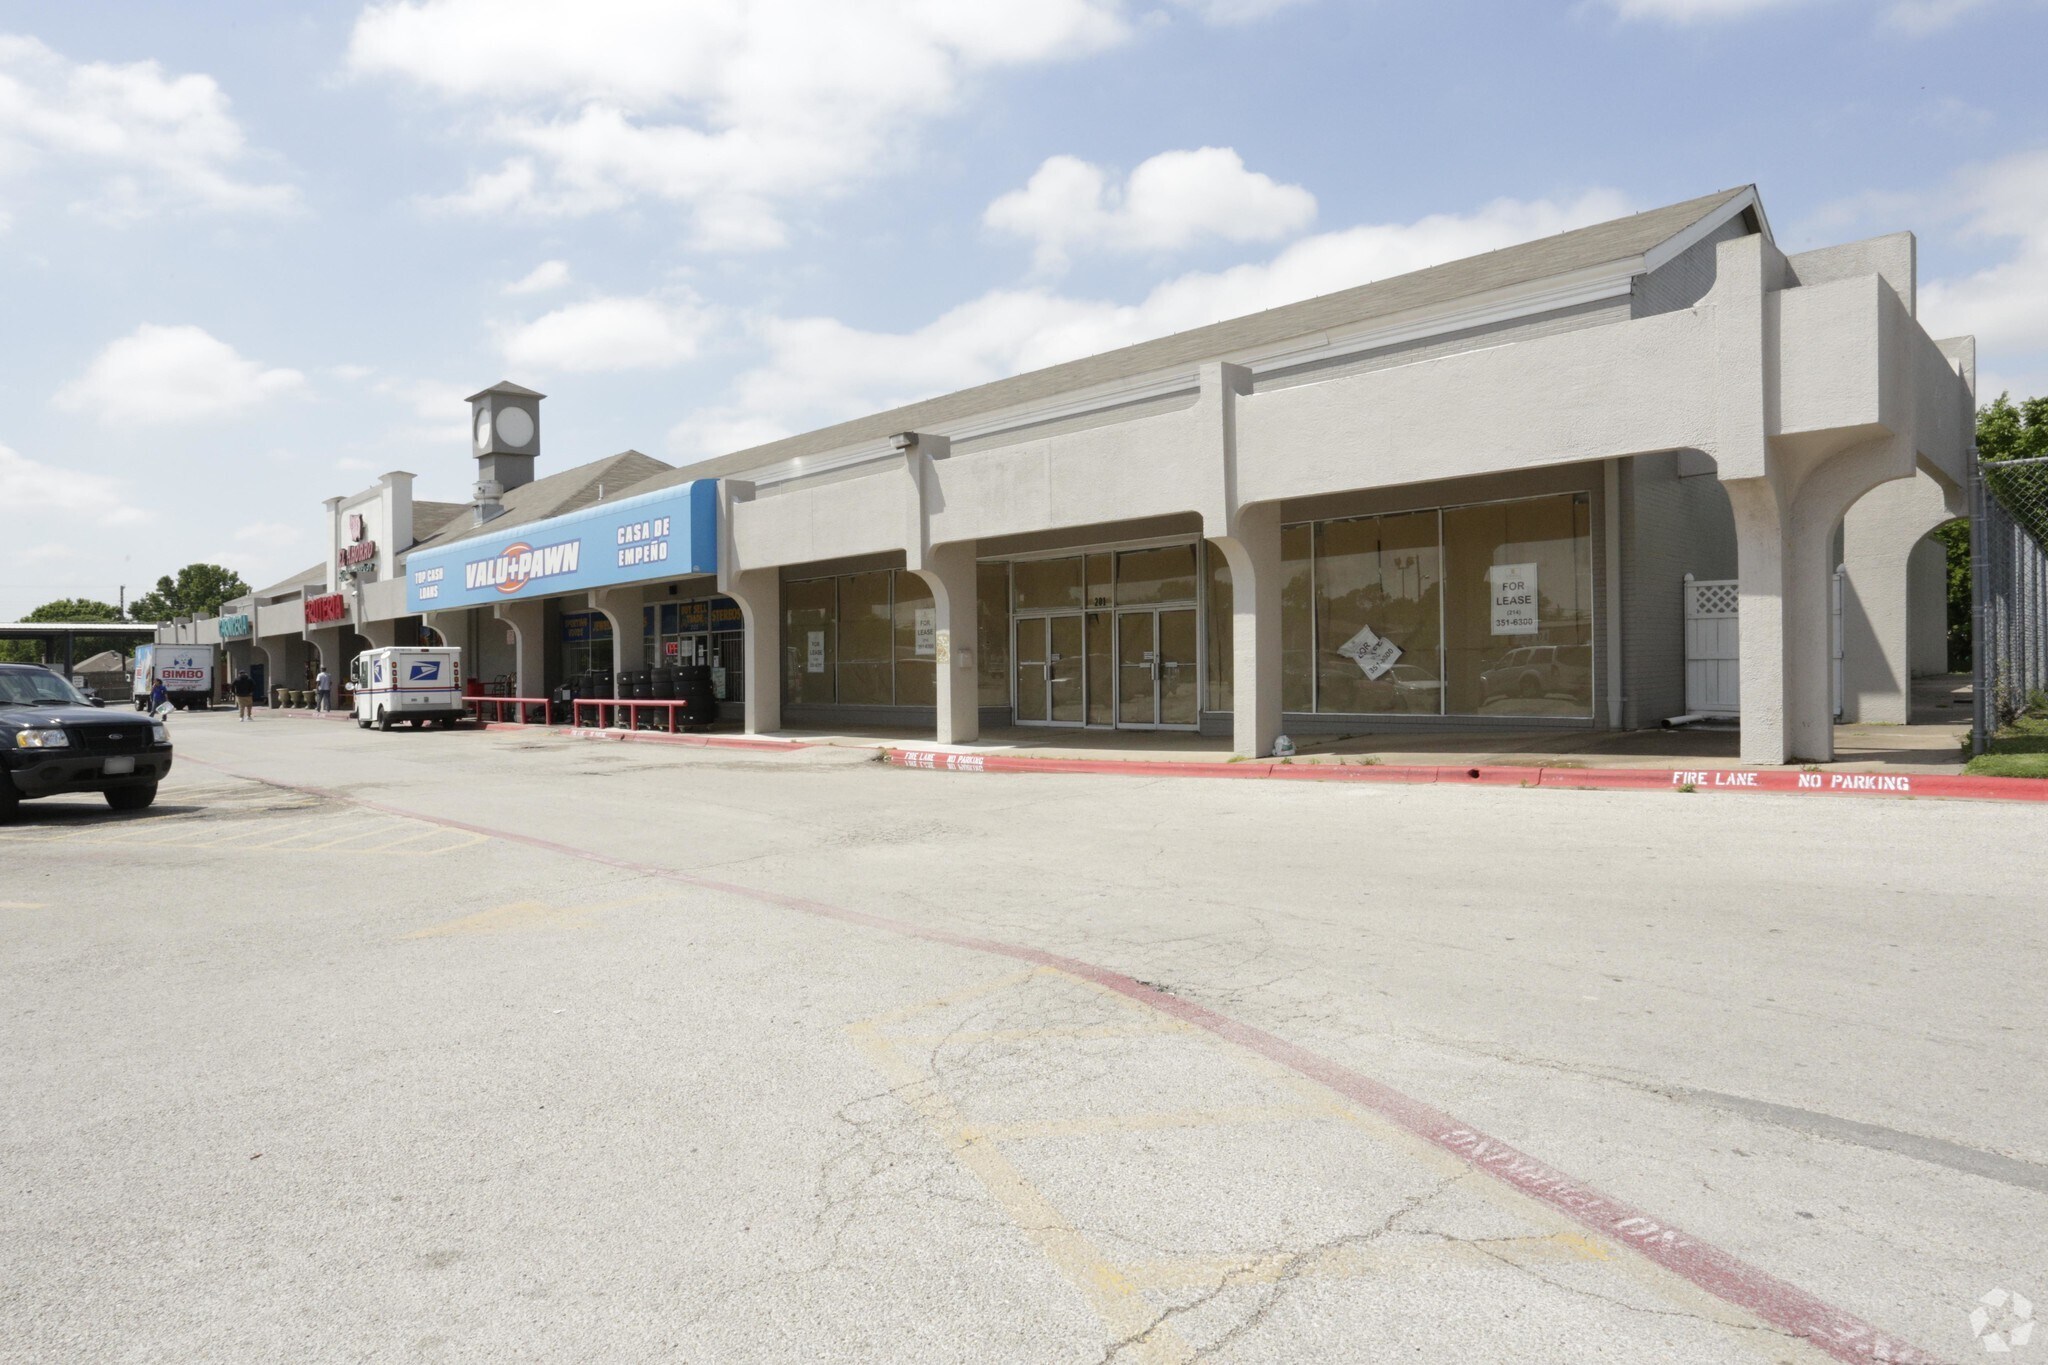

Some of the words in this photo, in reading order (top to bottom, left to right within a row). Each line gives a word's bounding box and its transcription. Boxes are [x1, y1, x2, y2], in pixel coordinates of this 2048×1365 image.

[617, 521, 650, 545] CASA
[654, 516, 670, 537] DE
[618, 540, 667, 567] EMPEÑO
[415, 570, 427, 585] TOP
[427, 567, 444, 582] CASH
[419, 585, 438, 600] LOANS
[1502, 582, 1524, 591] FOR
[1496, 595, 1532, 606] LEASE
[1496, 618, 1533, 627] 351-6300
[162, 670, 204, 679] BIMBO
[904, 751, 919, 761] FIRE
[919, 752, 936, 762] LANE
[946, 754, 957, 763] NO
[957, 755, 985, 766] PARKING
[1672, 772, 1708, 786] FIRE
[1715, 772, 1758, 787] LANE
[1798, 773, 1822, 789] NO
[1831, 774, 1910, 792] PARKING
